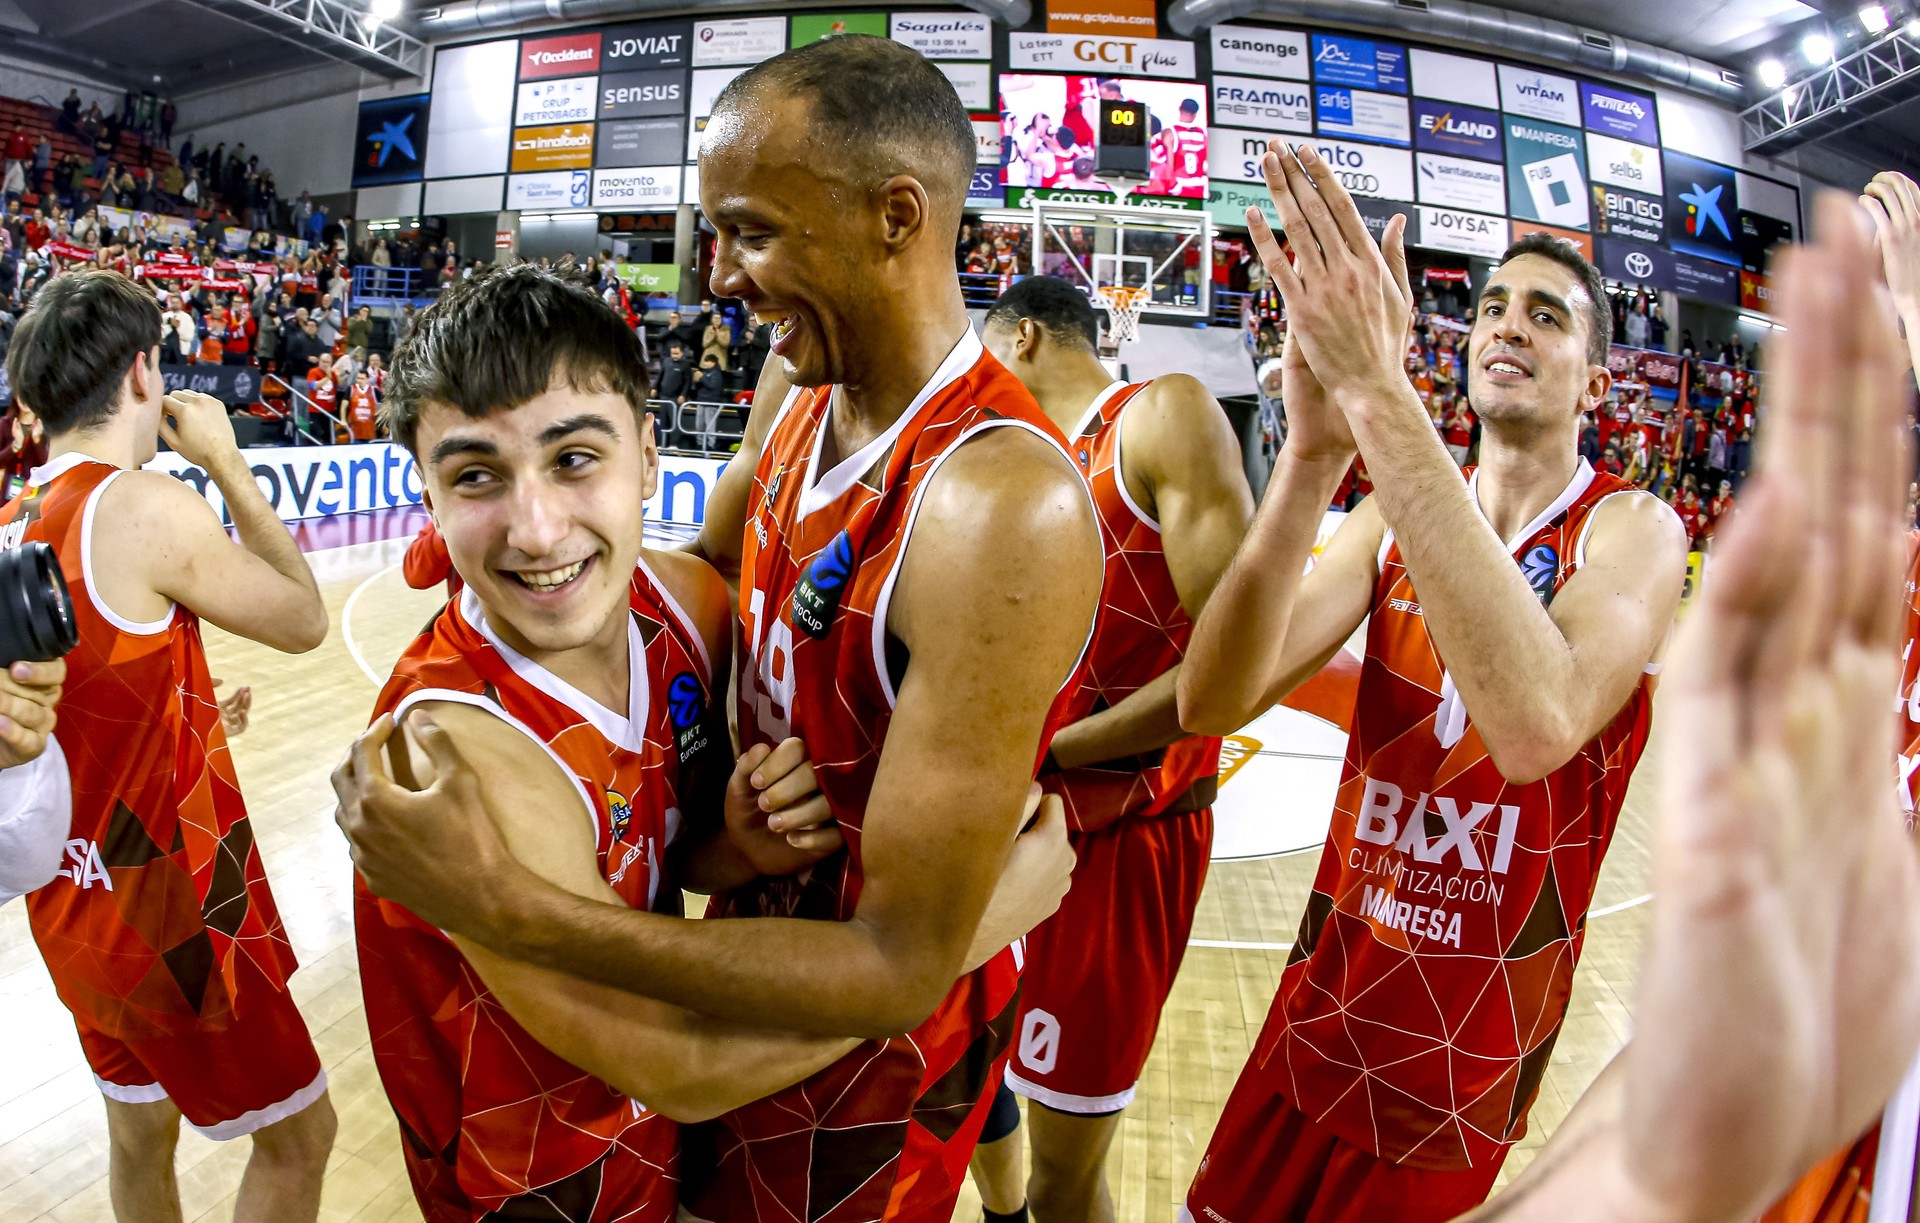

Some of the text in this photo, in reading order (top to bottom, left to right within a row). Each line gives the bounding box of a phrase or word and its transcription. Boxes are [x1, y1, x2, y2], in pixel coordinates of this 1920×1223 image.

[896, 21, 985, 33] Sagalés
[1049, 12, 1155, 25] www.gctplus.com
[542, 48, 593, 63] Occident
[609, 35, 681, 57] JOVIAT
[1220, 38, 1298, 58] canonge
[1032, 52, 1054, 62] ETT
[1073, 40, 1177, 72] GCT plus
[604, 84, 680, 104] sensus
[1516, 83, 1564, 102] VITAM
[542, 97, 570, 108] GRUP
[1111, 110, 1134, 126] 00
[1420, 113, 1497, 139] EXLAND
[600, 177, 655, 187] movento
[1529, 166, 1552, 182] FUB
[600, 187, 635, 198] sarsa
[616, 214, 676, 231] BAR
[799, 580, 824, 608] BKT
[792, 594, 823, 632] EuroCup
[680, 724, 701, 747] BKT
[680, 737, 708, 763] EuroCup
[1355, 775, 1521, 875] BAXI
[1018, 1007, 1061, 1075] 0
